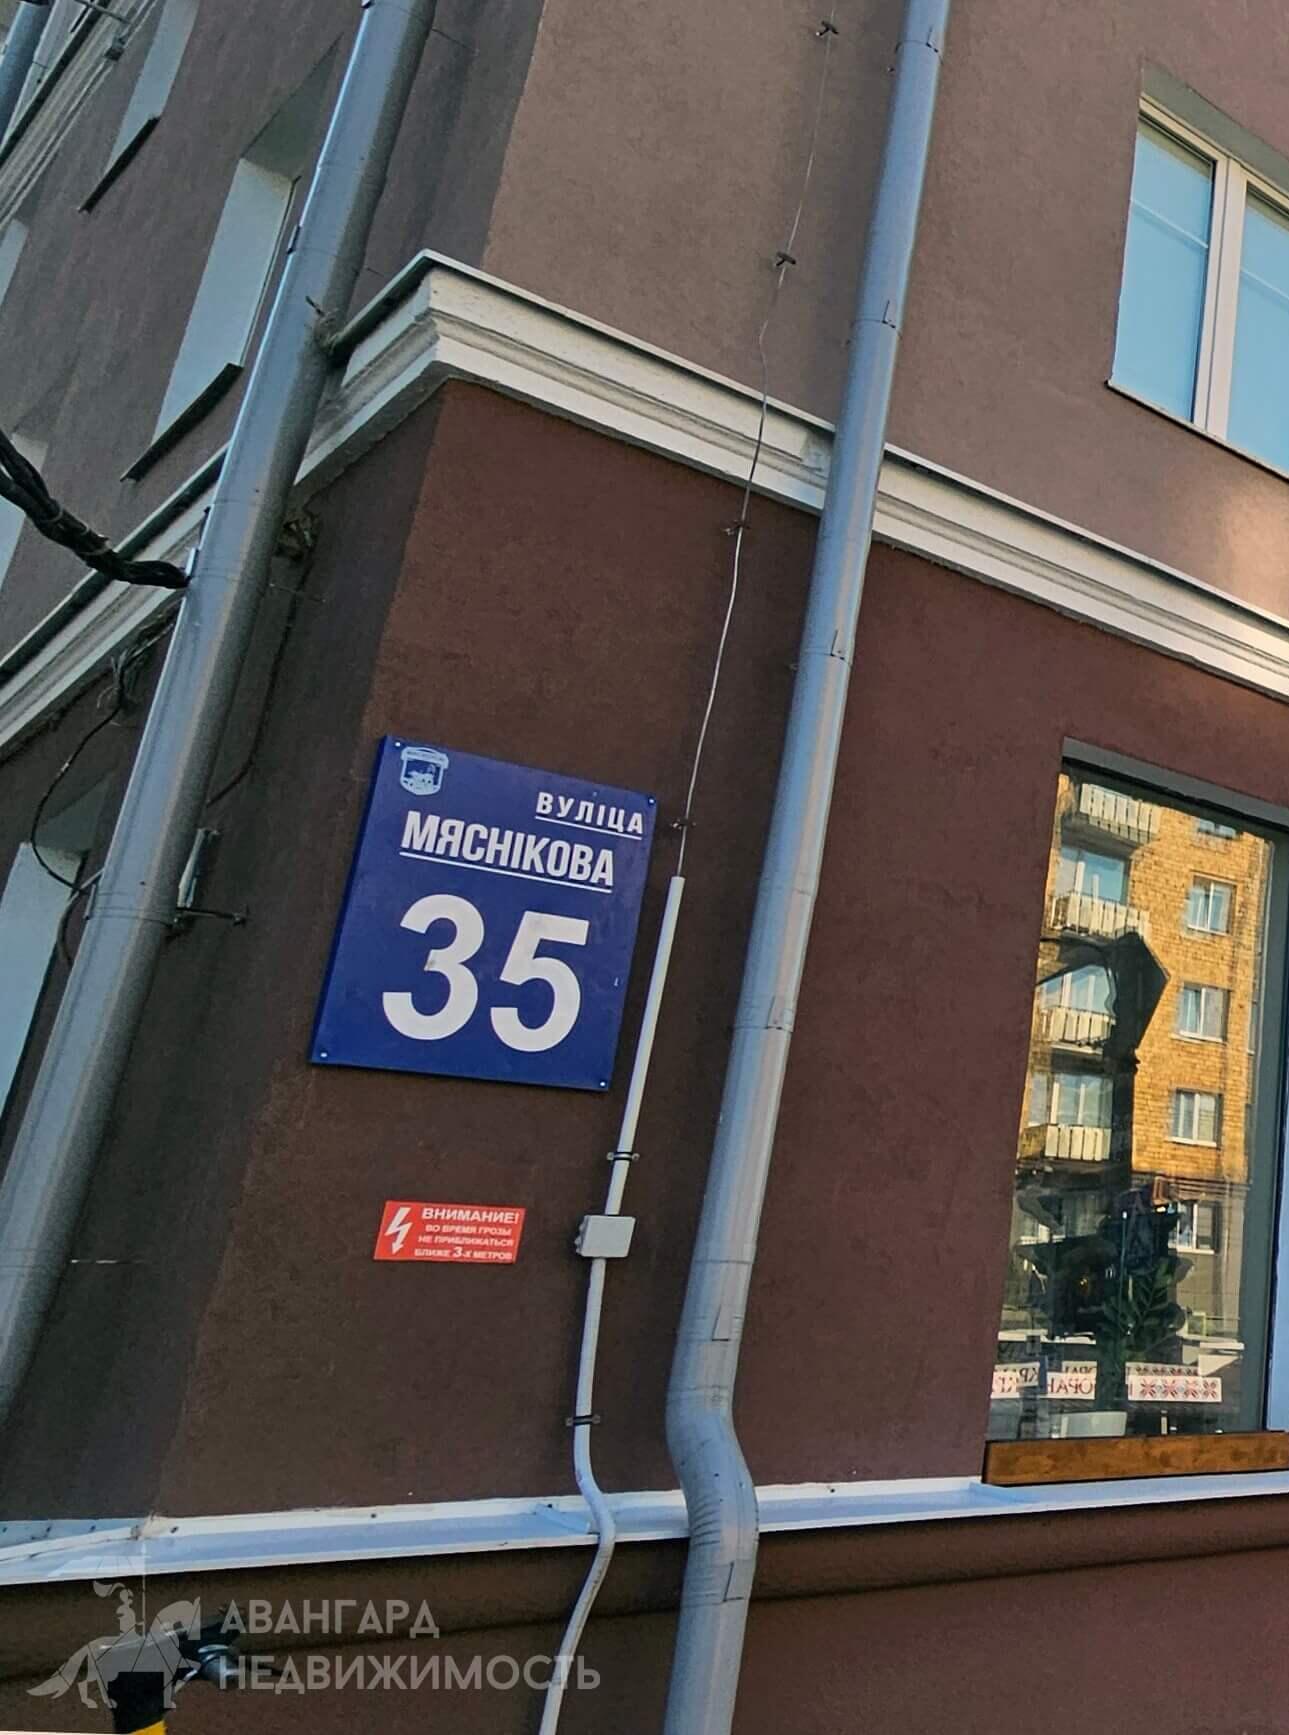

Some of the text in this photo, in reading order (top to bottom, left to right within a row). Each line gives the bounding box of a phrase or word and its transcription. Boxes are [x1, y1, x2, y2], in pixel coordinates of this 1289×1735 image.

[535, 792, 643, 834] ВУЛІЦА
[401, 811, 614, 886] МЯСНІКОВА
[382, 893, 590, 1053] 35
[421, 1207, 520, 1225] ВНИМАНИЕ!
[425, 1224, 512, 1236] ВО ВРЕМЯ ГРОЗЫ
[418, 1235, 513, 1247] НЕ ПРИБЛИЖАТЬСЯ
[414, 1248, 450, 1257] БЛИЖЕ
[473, 1250, 513, 1260] МЕТРОВ
